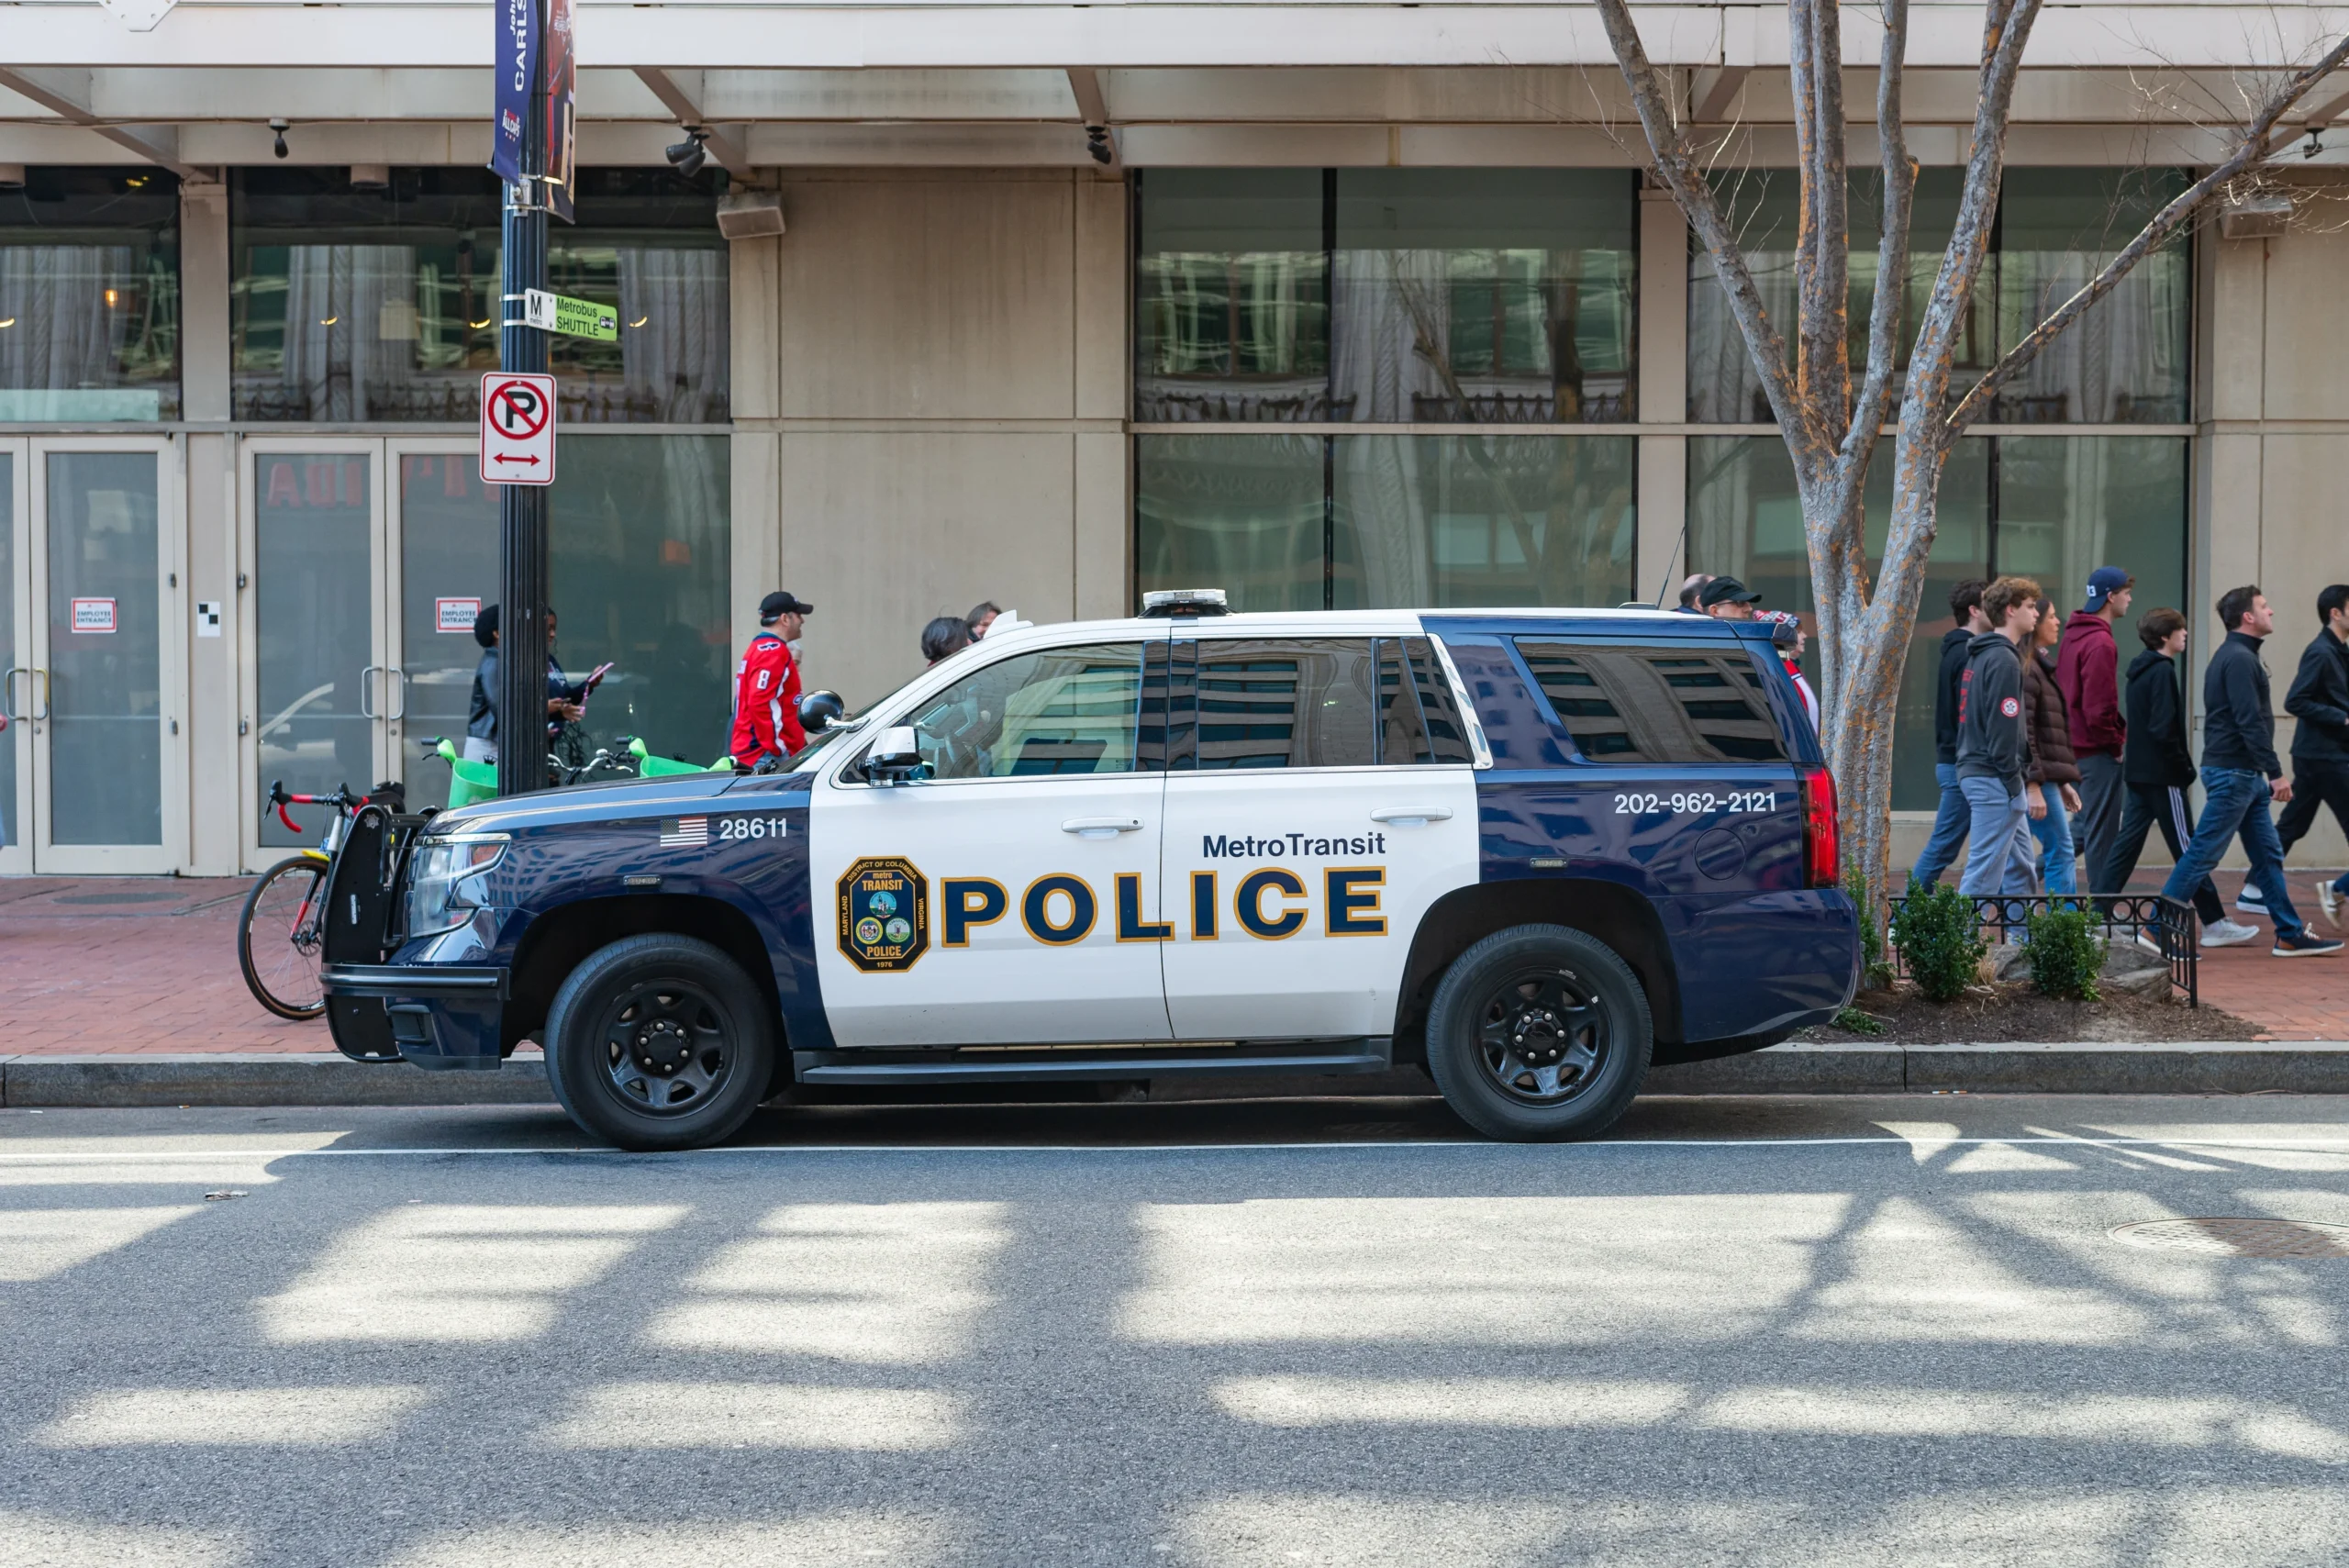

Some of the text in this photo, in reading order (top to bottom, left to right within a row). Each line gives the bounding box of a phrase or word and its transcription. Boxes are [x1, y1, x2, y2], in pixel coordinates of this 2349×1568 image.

[530, 295, 542, 317] M
[556, 297, 598, 318] Metrobus
[556, 316, 599, 337] SHUTTLE
[757, 669, 771, 690] 8
[1614, 792, 1776, 815] 202-962-2121
[719, 817, 786, 840] 28611
[1202, 832, 1386, 858] MetroTransit
[847, 862, 874, 882] DISTRICT
[885, 861, 918, 881] COLUMBIA
[862, 879, 904, 892] TRANSIT
[941, 865, 1388, 948] POLICE
[866, 946, 902, 957] POLICE
